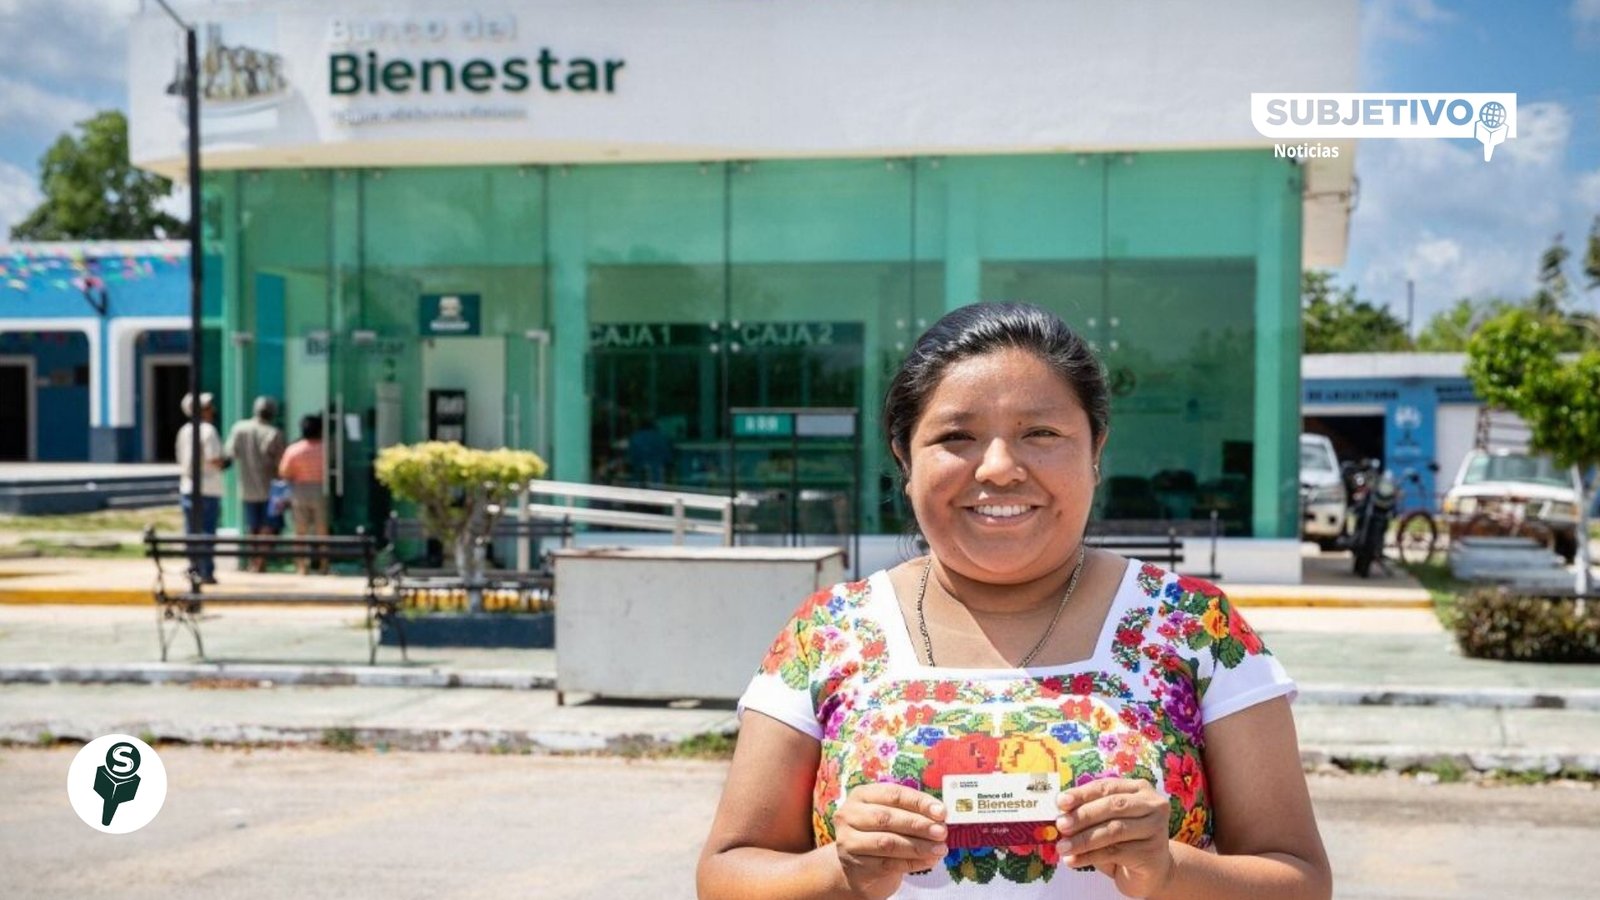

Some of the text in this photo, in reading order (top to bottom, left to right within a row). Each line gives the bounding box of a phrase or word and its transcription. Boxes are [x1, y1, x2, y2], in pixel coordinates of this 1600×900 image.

[461, 11, 517, 44] del
[329, 48, 625, 96] Bienestar
[590, 326, 670, 344] CAJA 1
[742, 325, 834, 344] CAJA 2
[977, 799, 1038, 809] Bienestar
